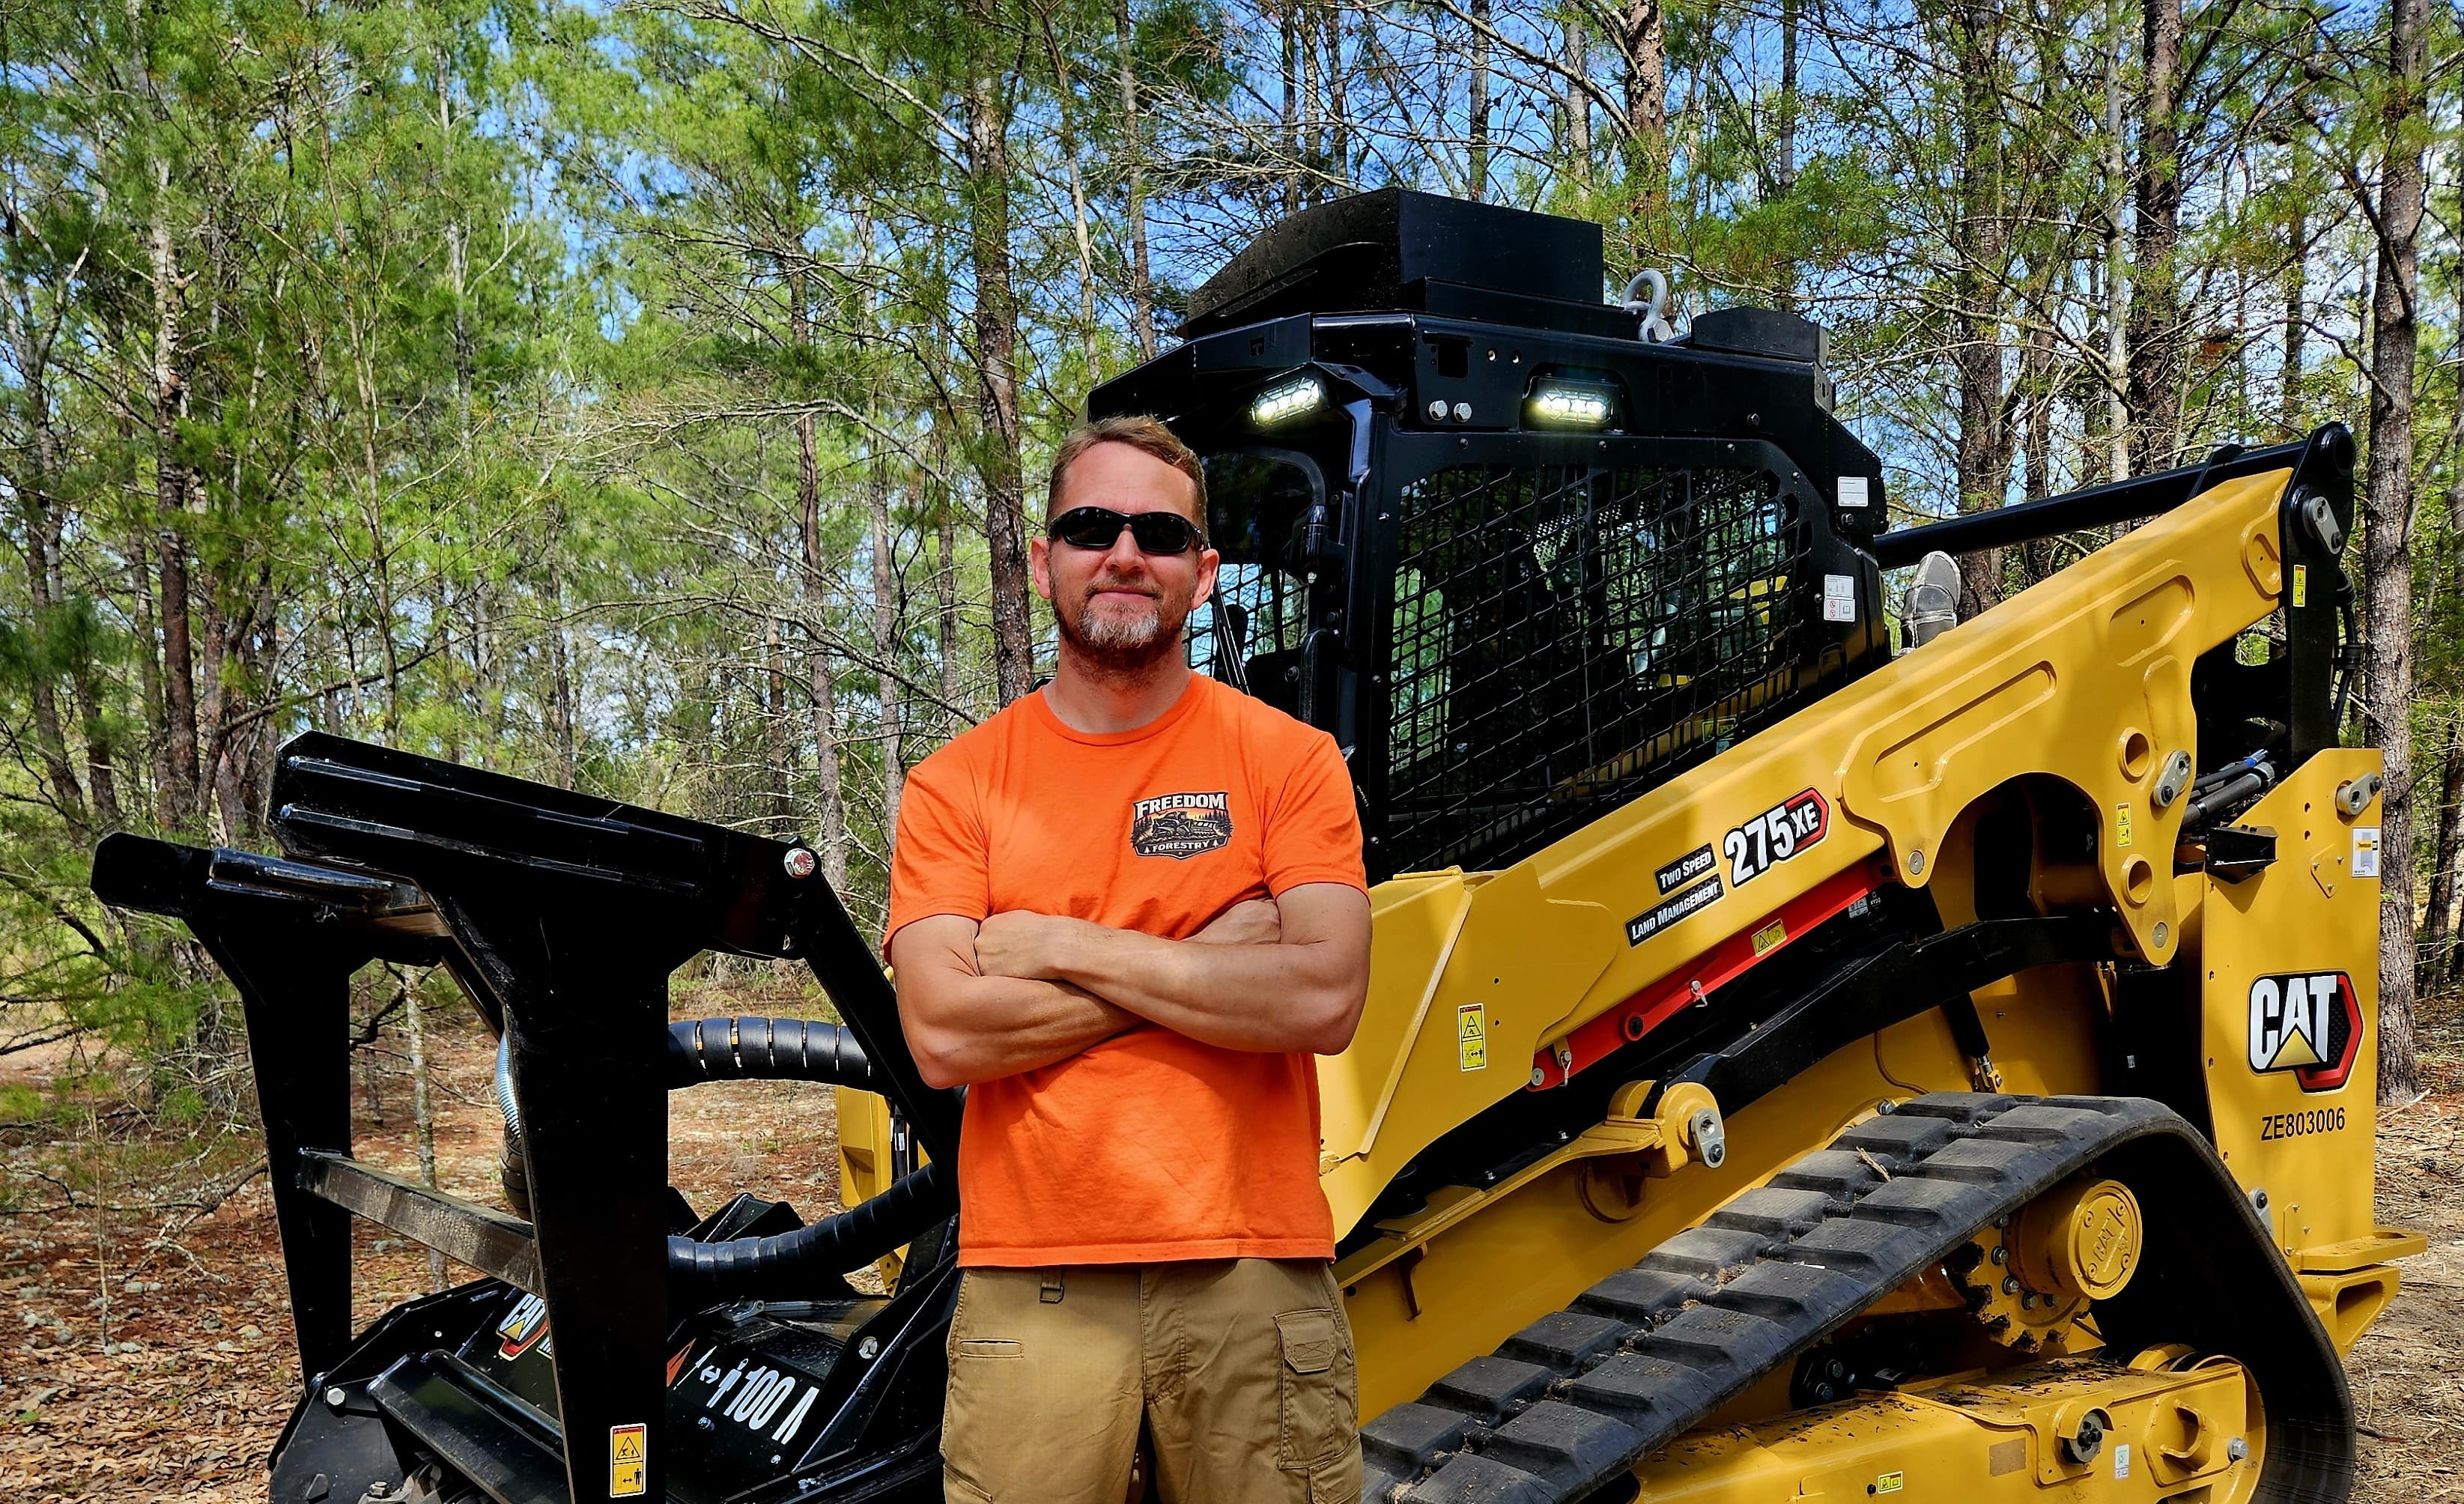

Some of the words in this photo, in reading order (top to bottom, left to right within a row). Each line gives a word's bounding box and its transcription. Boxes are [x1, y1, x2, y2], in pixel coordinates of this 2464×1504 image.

[1135, 793, 1226, 821] FREEDOM
[1153, 840, 1211, 852] FORESTRY
[2250, 974, 2337, 1070] CAT
[2261, 1107, 2346, 1141] ZE803006
[723, 1365, 796, 1431] 100
